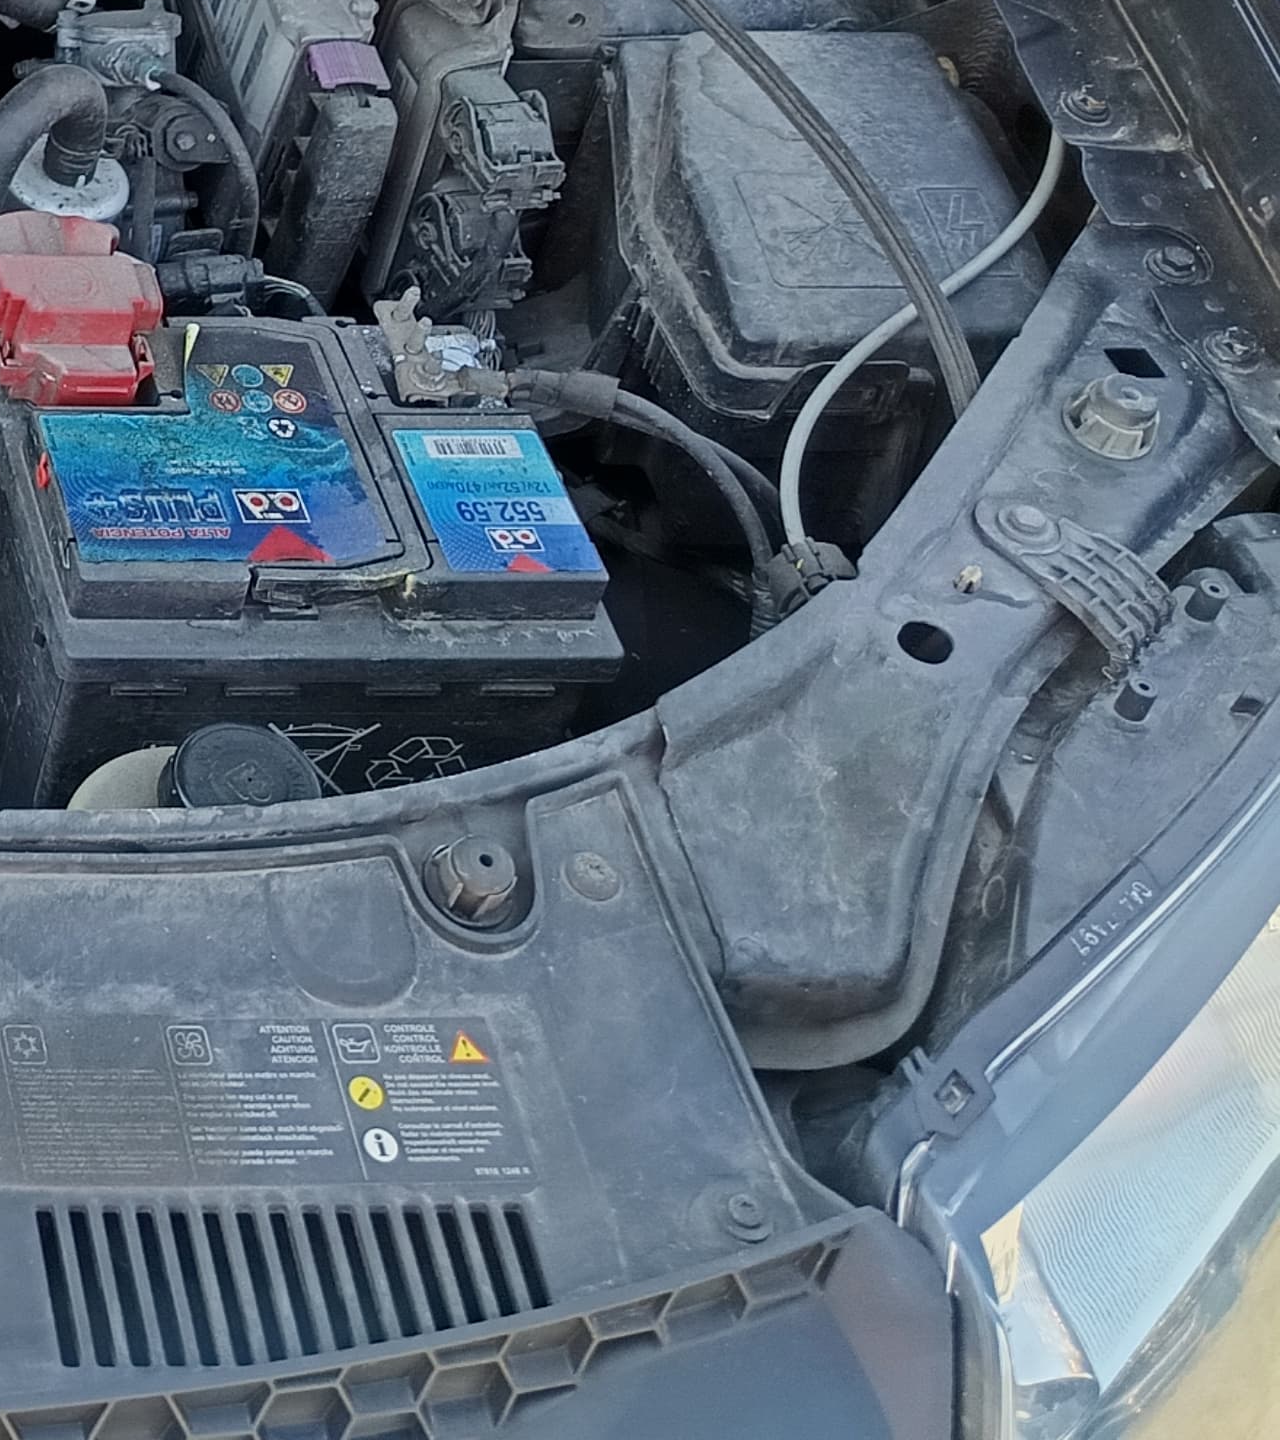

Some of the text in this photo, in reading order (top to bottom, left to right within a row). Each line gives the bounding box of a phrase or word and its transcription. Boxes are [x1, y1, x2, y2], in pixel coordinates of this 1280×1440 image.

[456, 501, 546, 522] 552.59
[93, 526, 230, 539] ALTA POTENCIA
[259, 1025, 310, 1034] ATTENTION
[384, 1024, 435, 1033] CONTROLE
[392, 1034, 439, 1042] CONTROL
[270, 1045, 315, 1053] ACHTUNG
